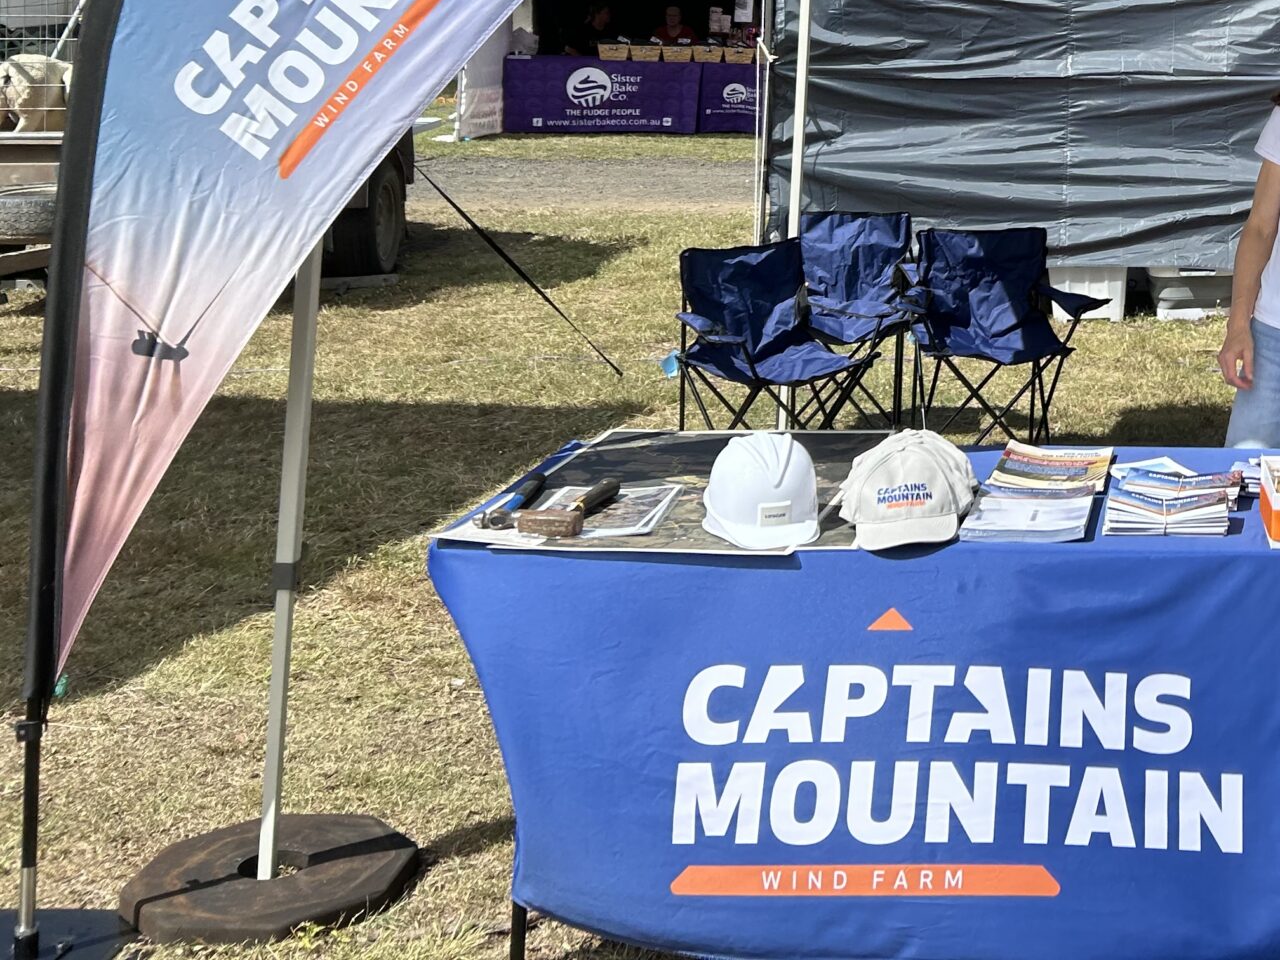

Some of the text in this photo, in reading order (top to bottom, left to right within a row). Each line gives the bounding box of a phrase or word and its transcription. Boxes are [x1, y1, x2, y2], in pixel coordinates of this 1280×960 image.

[314, 23, 410, 128] WIND FARM
[611, 73, 643, 83] Sister
[612, 83, 639, 92] Bake
[565, 108, 641, 116] THE FUDGE PEOPLE
[546, 117, 661, 127] www.sisterbakeco.com.au
[877, 483, 927, 495] CAPTAINS
[877, 491, 933, 504] MOUNTAIN
[682, 664, 1193, 755] CAPTAINS
[671, 759, 1244, 854] MOUNTAIN
[761, 870, 965, 890] WIND FARM
